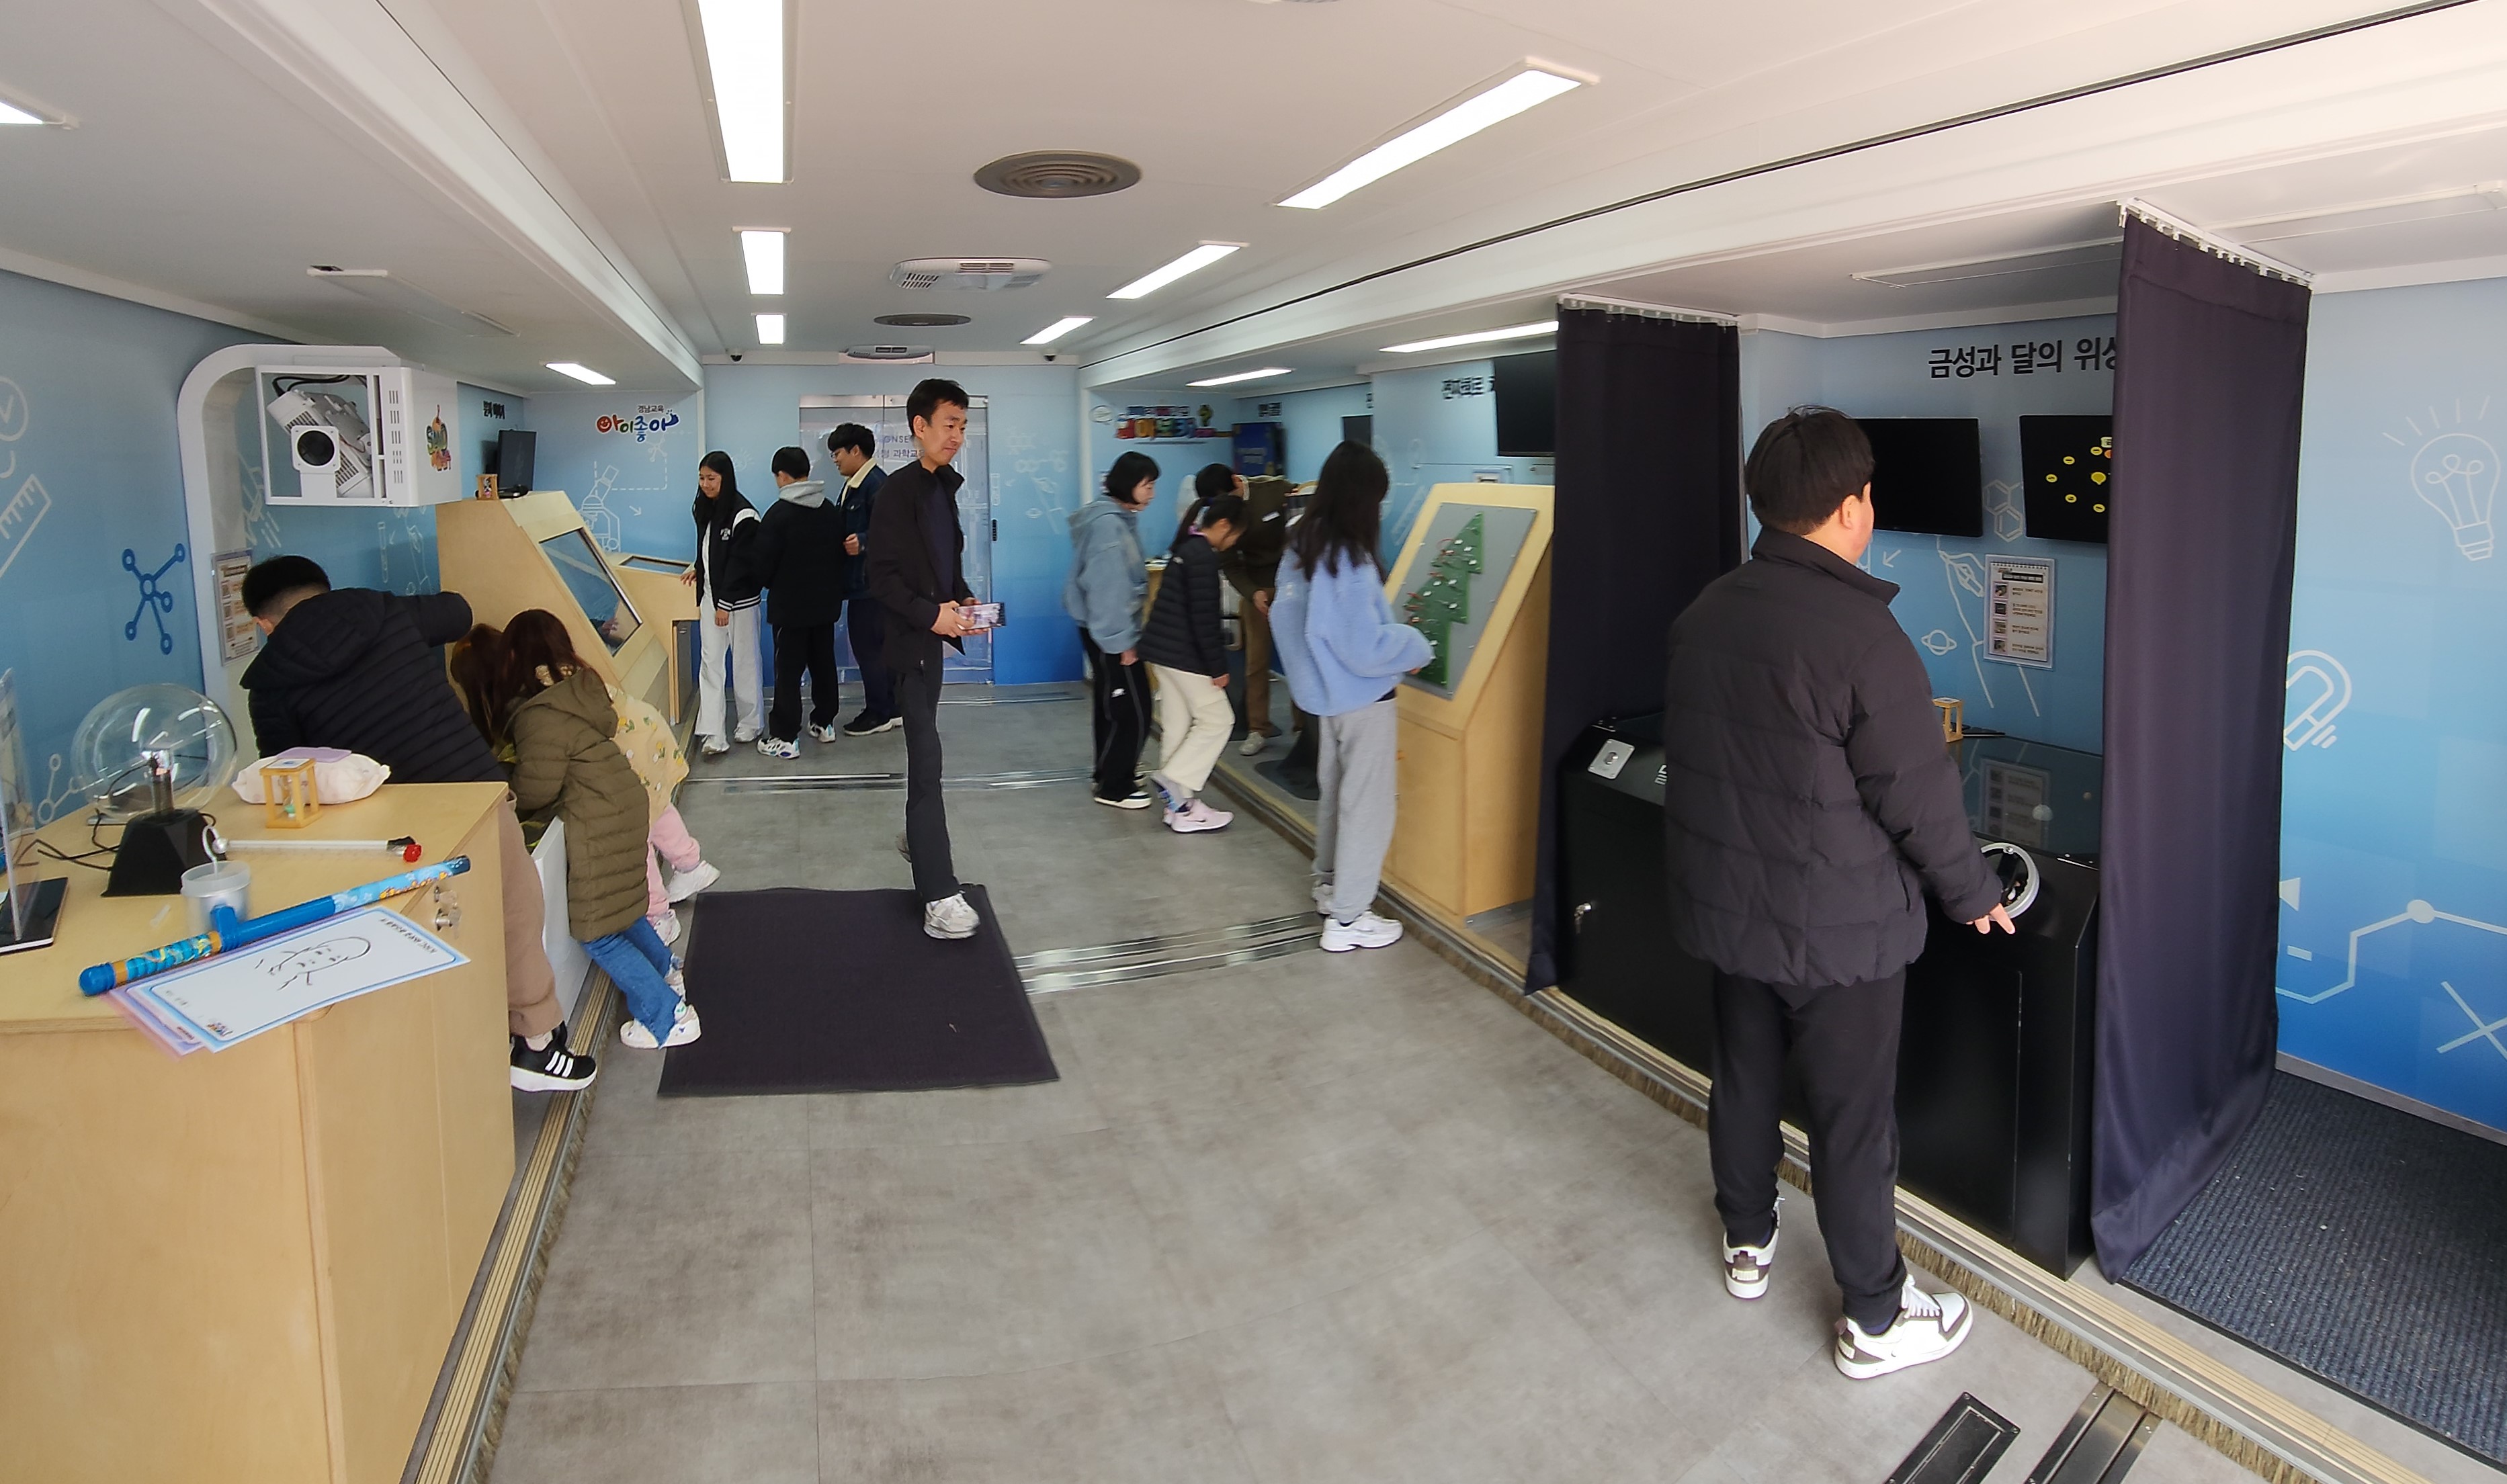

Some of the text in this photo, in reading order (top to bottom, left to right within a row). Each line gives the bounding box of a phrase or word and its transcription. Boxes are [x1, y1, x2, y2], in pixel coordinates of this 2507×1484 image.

[1928, 344, 2002, 378] 금성과
[2011, 340, 2063, 374] 달의
[637, 405, 664, 413] 경남교육
[596, 412, 679, 443] 아이좋아
